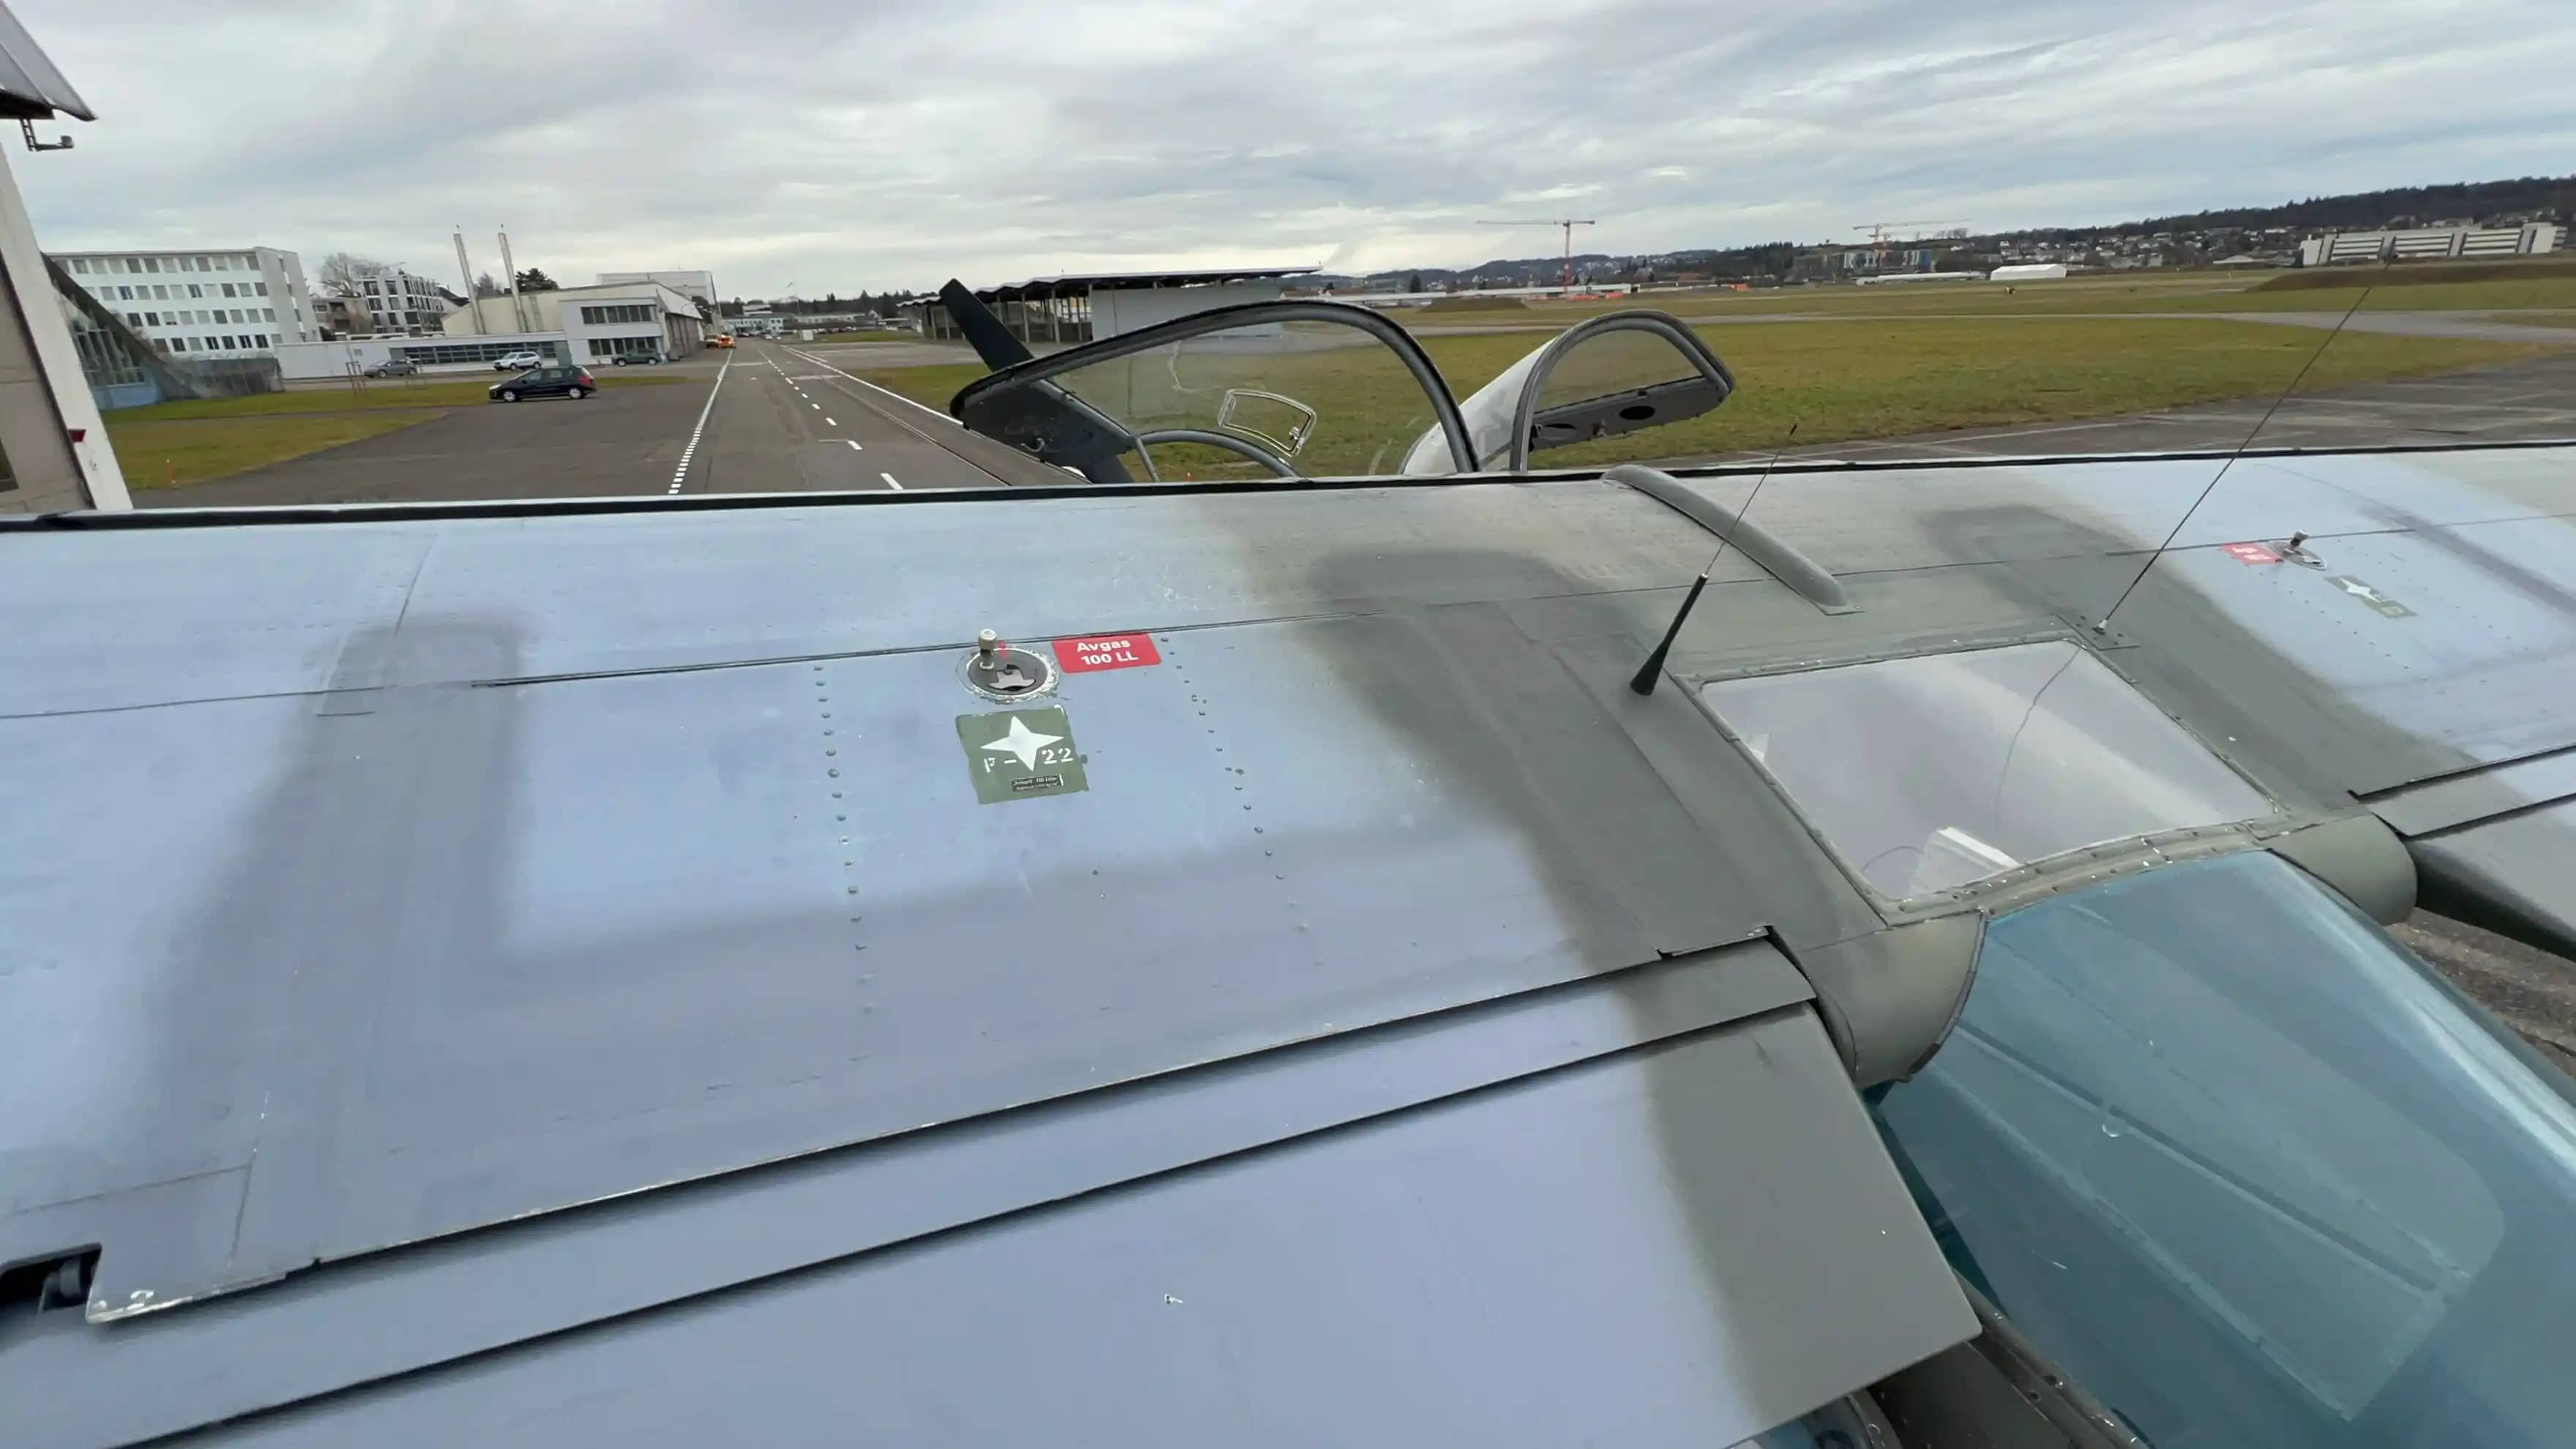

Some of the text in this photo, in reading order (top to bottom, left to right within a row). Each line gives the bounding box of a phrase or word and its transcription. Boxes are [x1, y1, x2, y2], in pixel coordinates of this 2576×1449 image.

[1077, 640, 1131, 653] Avgas
[1081, 651, 1139, 665] 100 LL
